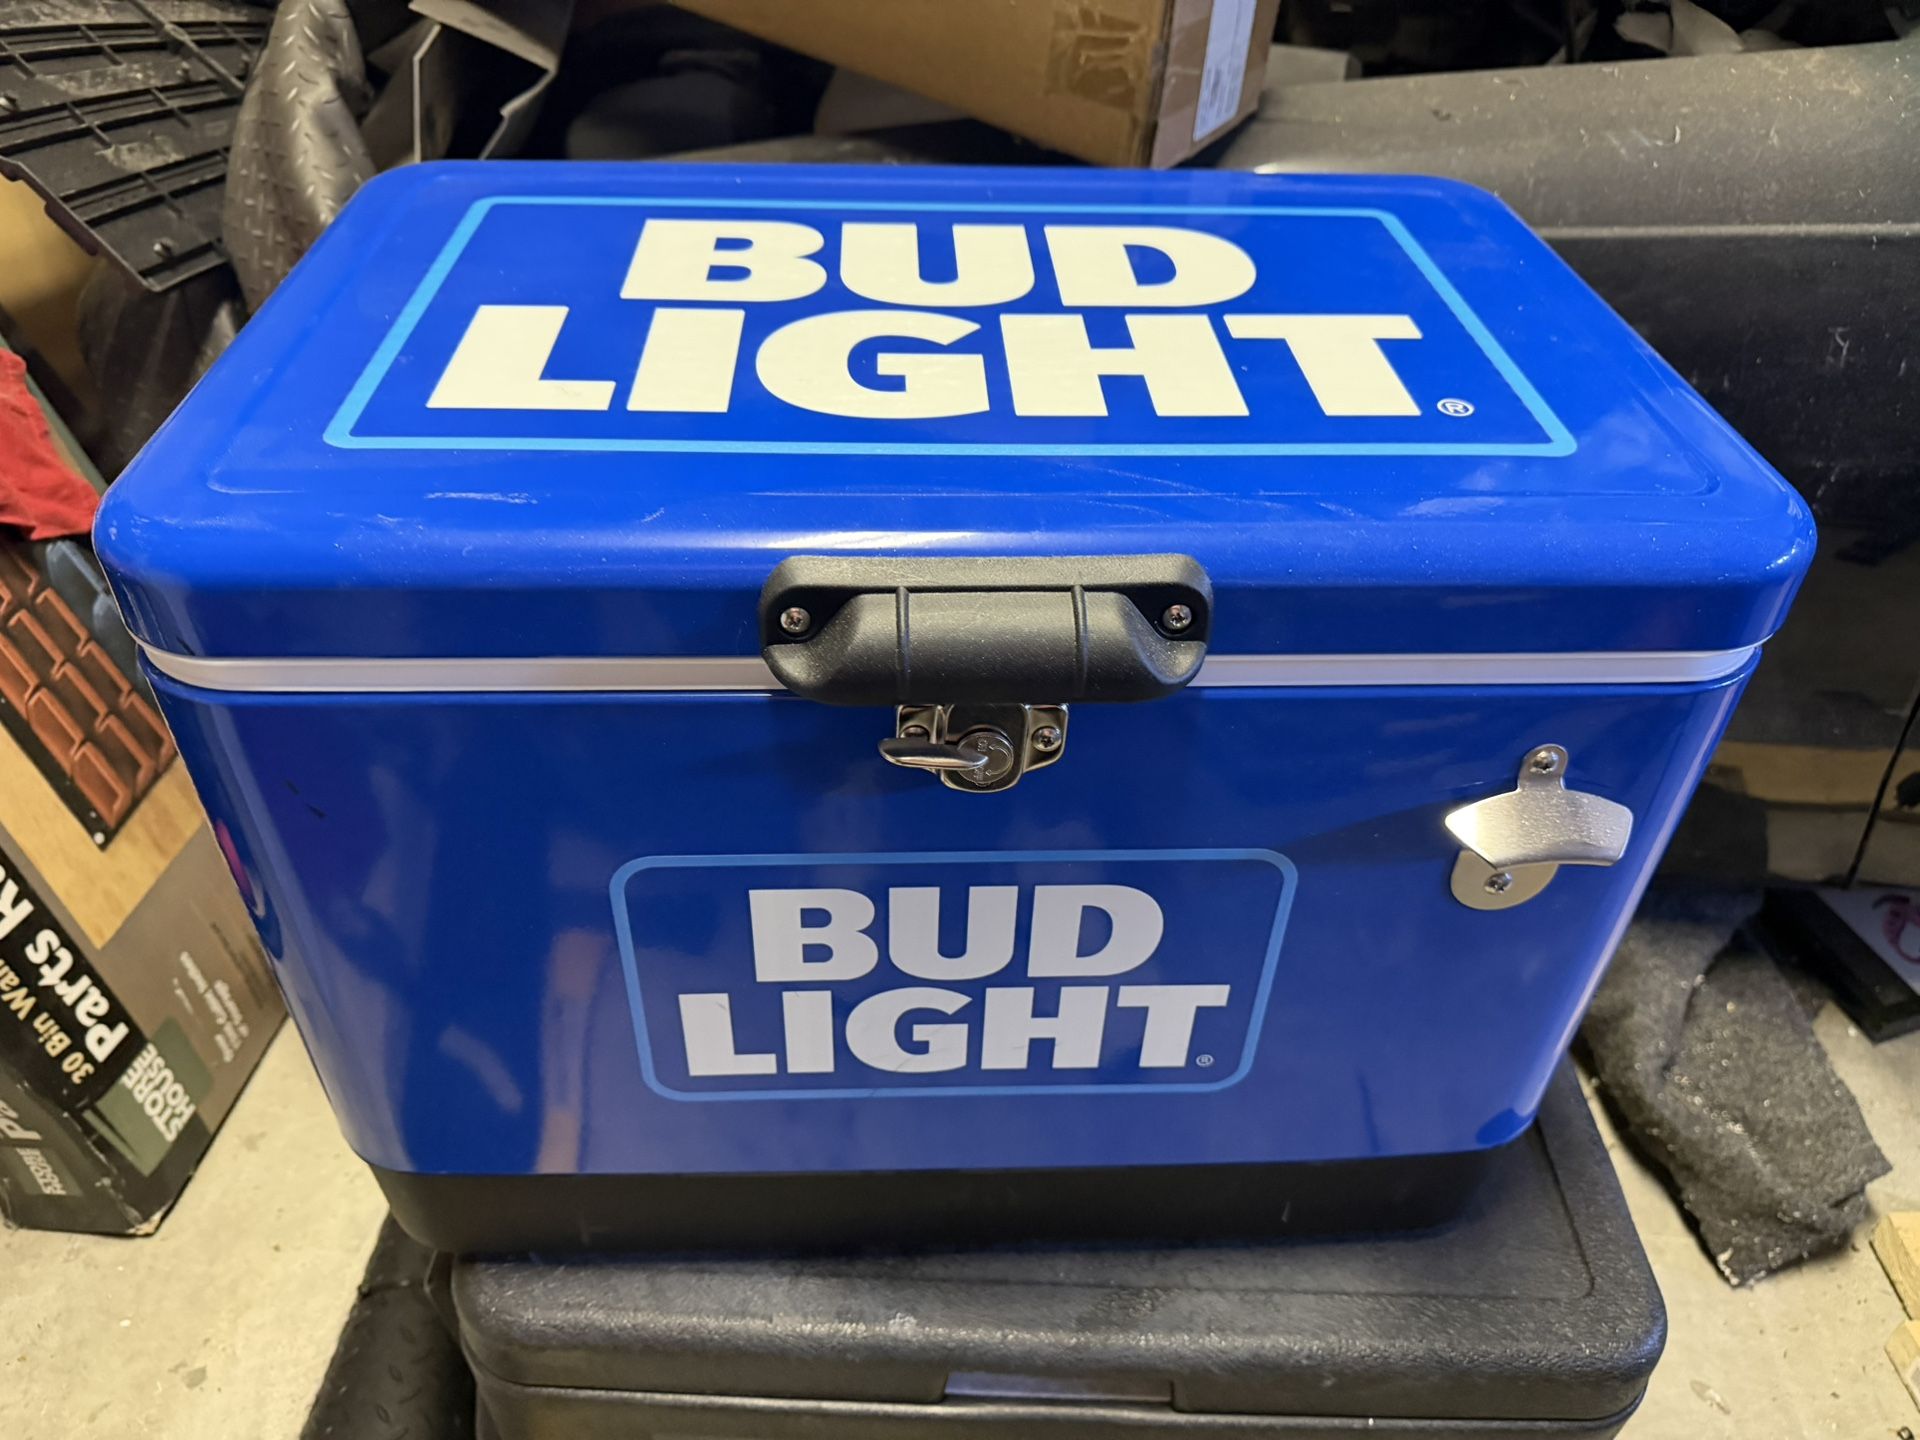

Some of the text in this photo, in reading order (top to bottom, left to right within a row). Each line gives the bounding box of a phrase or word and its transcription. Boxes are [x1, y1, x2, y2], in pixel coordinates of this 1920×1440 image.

[620, 218, 1257, 308] BUD
[426, 304, 1422, 420] LIGHT
[748, 884, 1164, 982] BUD
[0, 958, 95, 1085] 30 Bin Wa
[24, 928, 130, 1063] Parts
[678, 984, 1230, 1076] LIGHT
[120, 1061, 184, 1143] STORE
[137, 1042, 197, 1122] HOUSE
